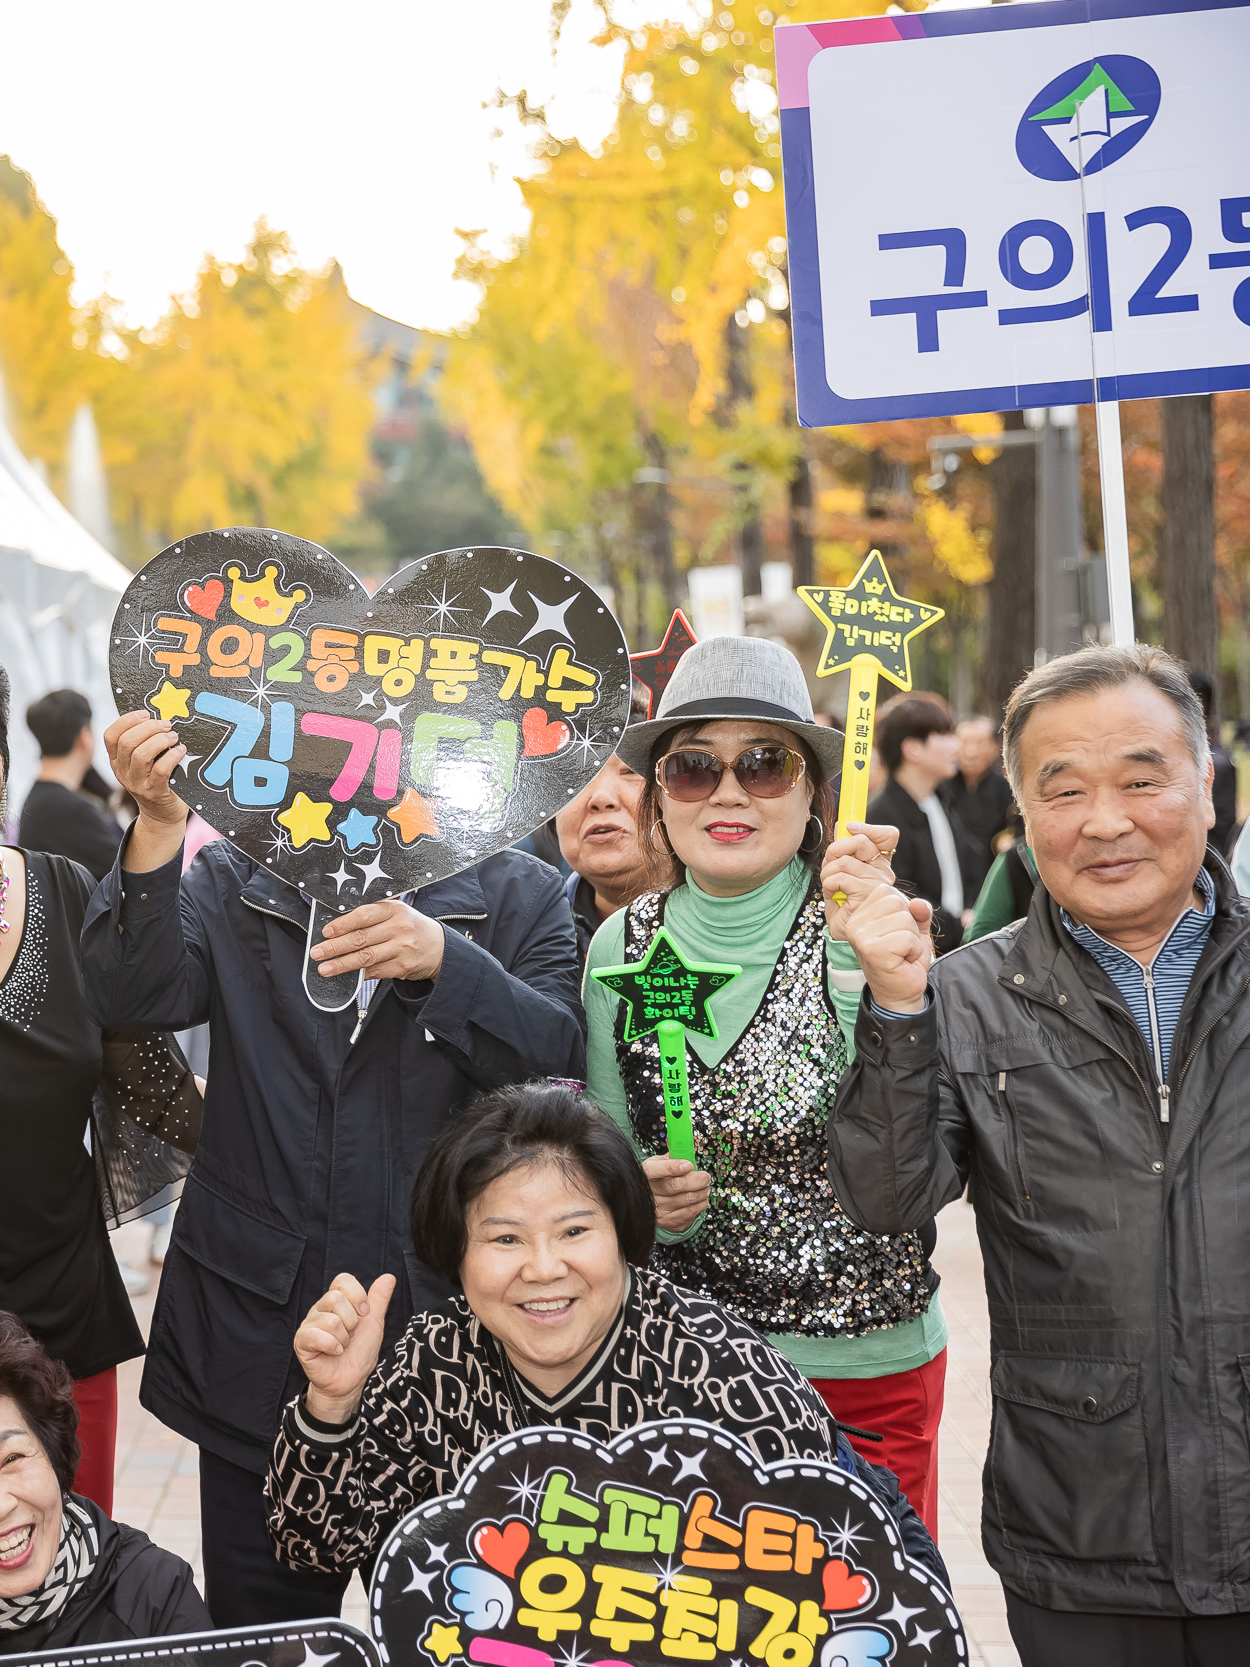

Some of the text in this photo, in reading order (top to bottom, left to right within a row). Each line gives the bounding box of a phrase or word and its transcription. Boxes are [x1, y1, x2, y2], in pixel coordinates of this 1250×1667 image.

[827, 590, 914, 623] 폼미쳤다
[837, 622, 902, 653] 김기덕
[634, 973, 699, 989] 빛이나는
[642, 989, 694, 1005] 구의2동
[644, 1006, 696, 1020] 화이팅
[539, 1473, 824, 1574] 슈퍼스타
[517, 1556, 828, 1667] 우주최강
